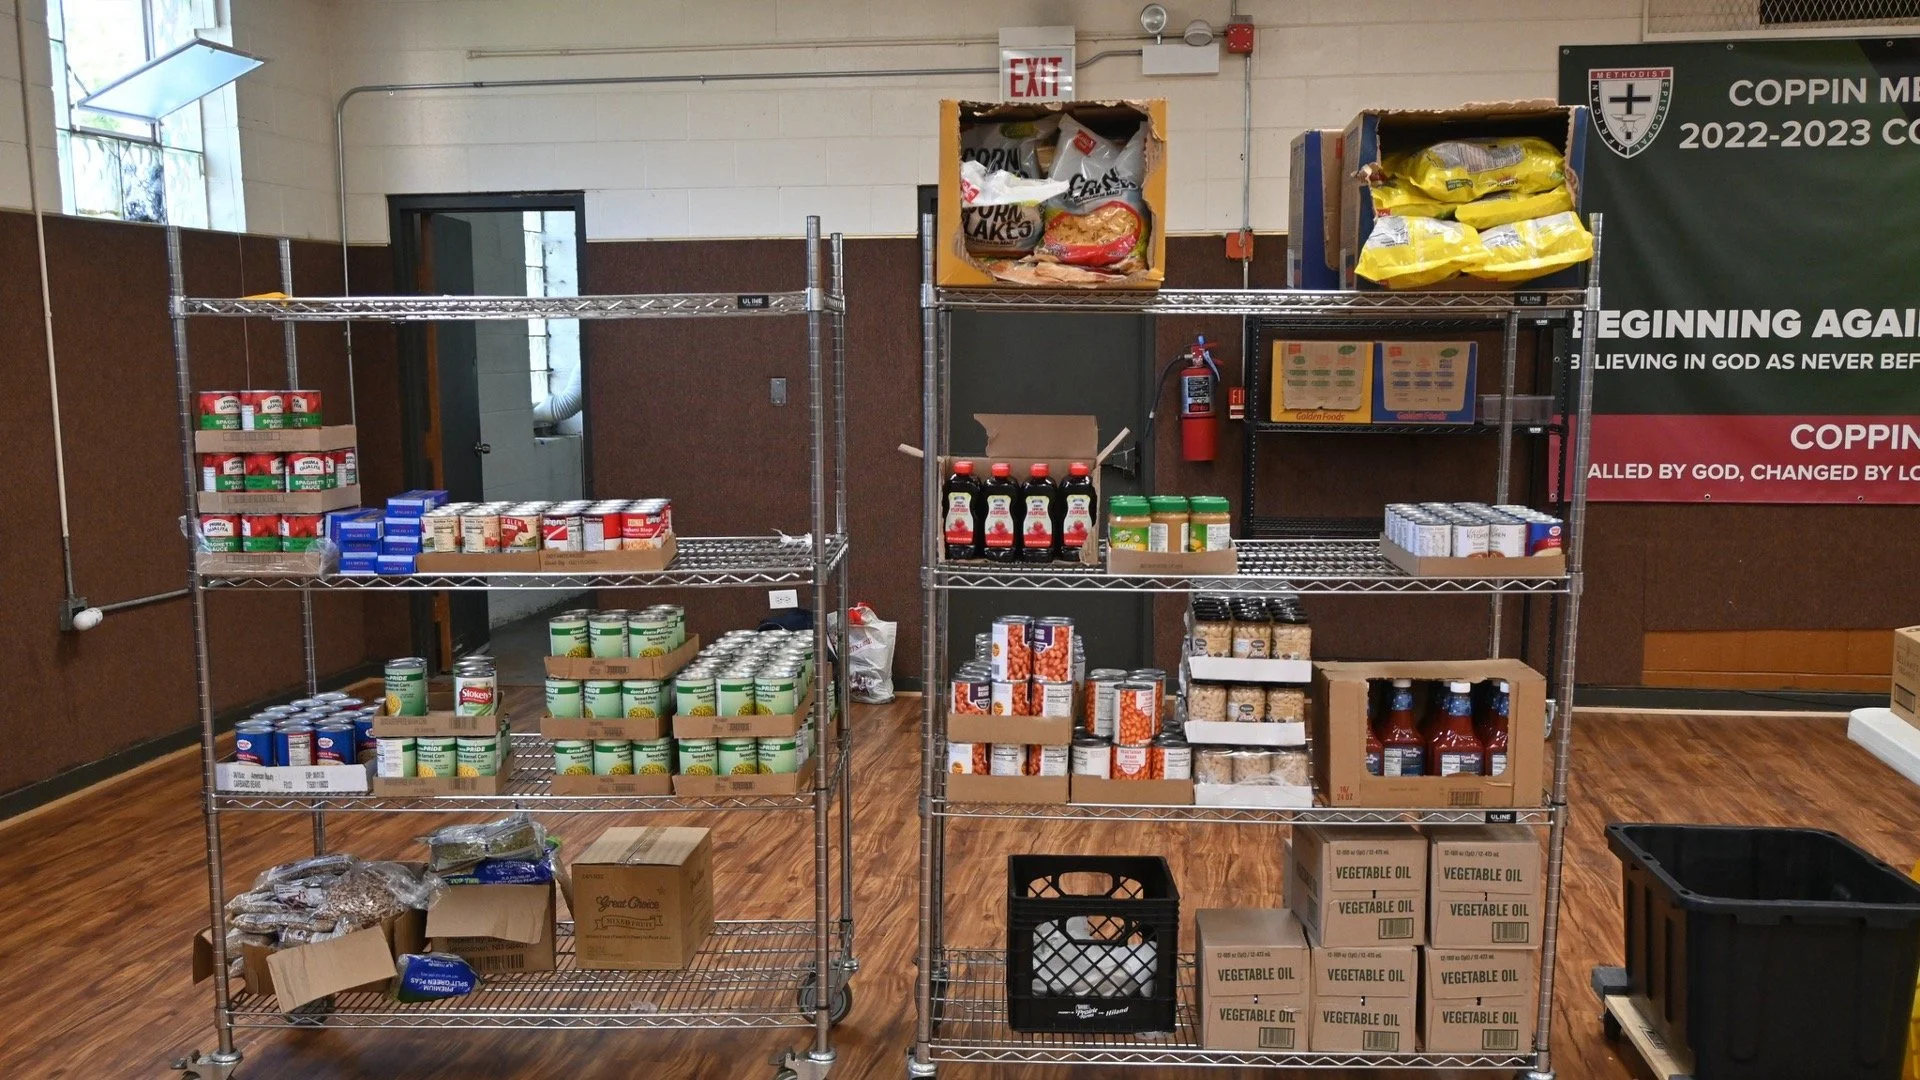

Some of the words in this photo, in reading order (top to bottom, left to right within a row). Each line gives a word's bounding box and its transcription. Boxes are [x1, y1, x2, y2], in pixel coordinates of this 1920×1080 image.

[1010, 57, 1062, 97] EXIT
[1596, 70, 1665, 79] METHODIST
[1729, 78, 1867, 106] COPPIN
[1592, 84, 1624, 151] AFRICAN
[1635, 81, 1669, 149] EPISCOPAL
[1679, 119, 1871, 149] 2022-2023
[1812, 309, 1920, 339] AGAI
[1571, 353, 1677, 370] BLIEVING
[1684, 354, 1706, 369] IN
[1712, 353, 1760, 370] GOD
[1766, 353, 1795, 370] AS
[1801, 353, 1872, 370] NEVER
[1296, 412, 1322, 421] Golden
[1323, 412, 1345, 421] Foods
[1790, 424, 1920, 450] COPPIN
[1587, 463, 1652, 479] ALLED
[1659, 464, 1687, 479] BY
[1692, 464, 1745, 482] GOD,
[1751, 465, 1858, 480] CHANGED
[1864, 465, 1893, 480] BY
[1336, 866, 1392, 879] VEGETABLE
[1395, 866, 1411, 879] OIL
[1443, 866, 1502, 881] VEGETABLE
[1505, 868, 1522, 882] OIL
[596, 896, 628, 912] Great
[628, 896, 660, 909] Choice
[1339, 901, 1394, 914] VEGETABLE
[1397, 900, 1414, 913] OIL
[1450, 903, 1509, 916] VEGETABLE
[1511, 904, 1529, 917] OIL
[1217, 968, 1274, 981] VEGETABLE
[1278, 967, 1295, 979] OIL
[1327, 969, 1385, 981] VEGETABLE
[1388, 969, 1405, 982] OIL
[1441, 970, 1498, 984] VEGETABLE
[1501, 969, 1519, 982] OIL
[423, 985, 454, 993] PREMIUM
[1219, 1008, 1276, 1022] VEGETABLE
[1279, 1010, 1296, 1023] OIL
[1323, 1011, 1380, 1025] VEGETABLE
[1383, 1013, 1400, 1026] OIL
[1442, 1011, 1499, 1024] VEGETABLE
[1502, 1011, 1519, 1024] OIL
